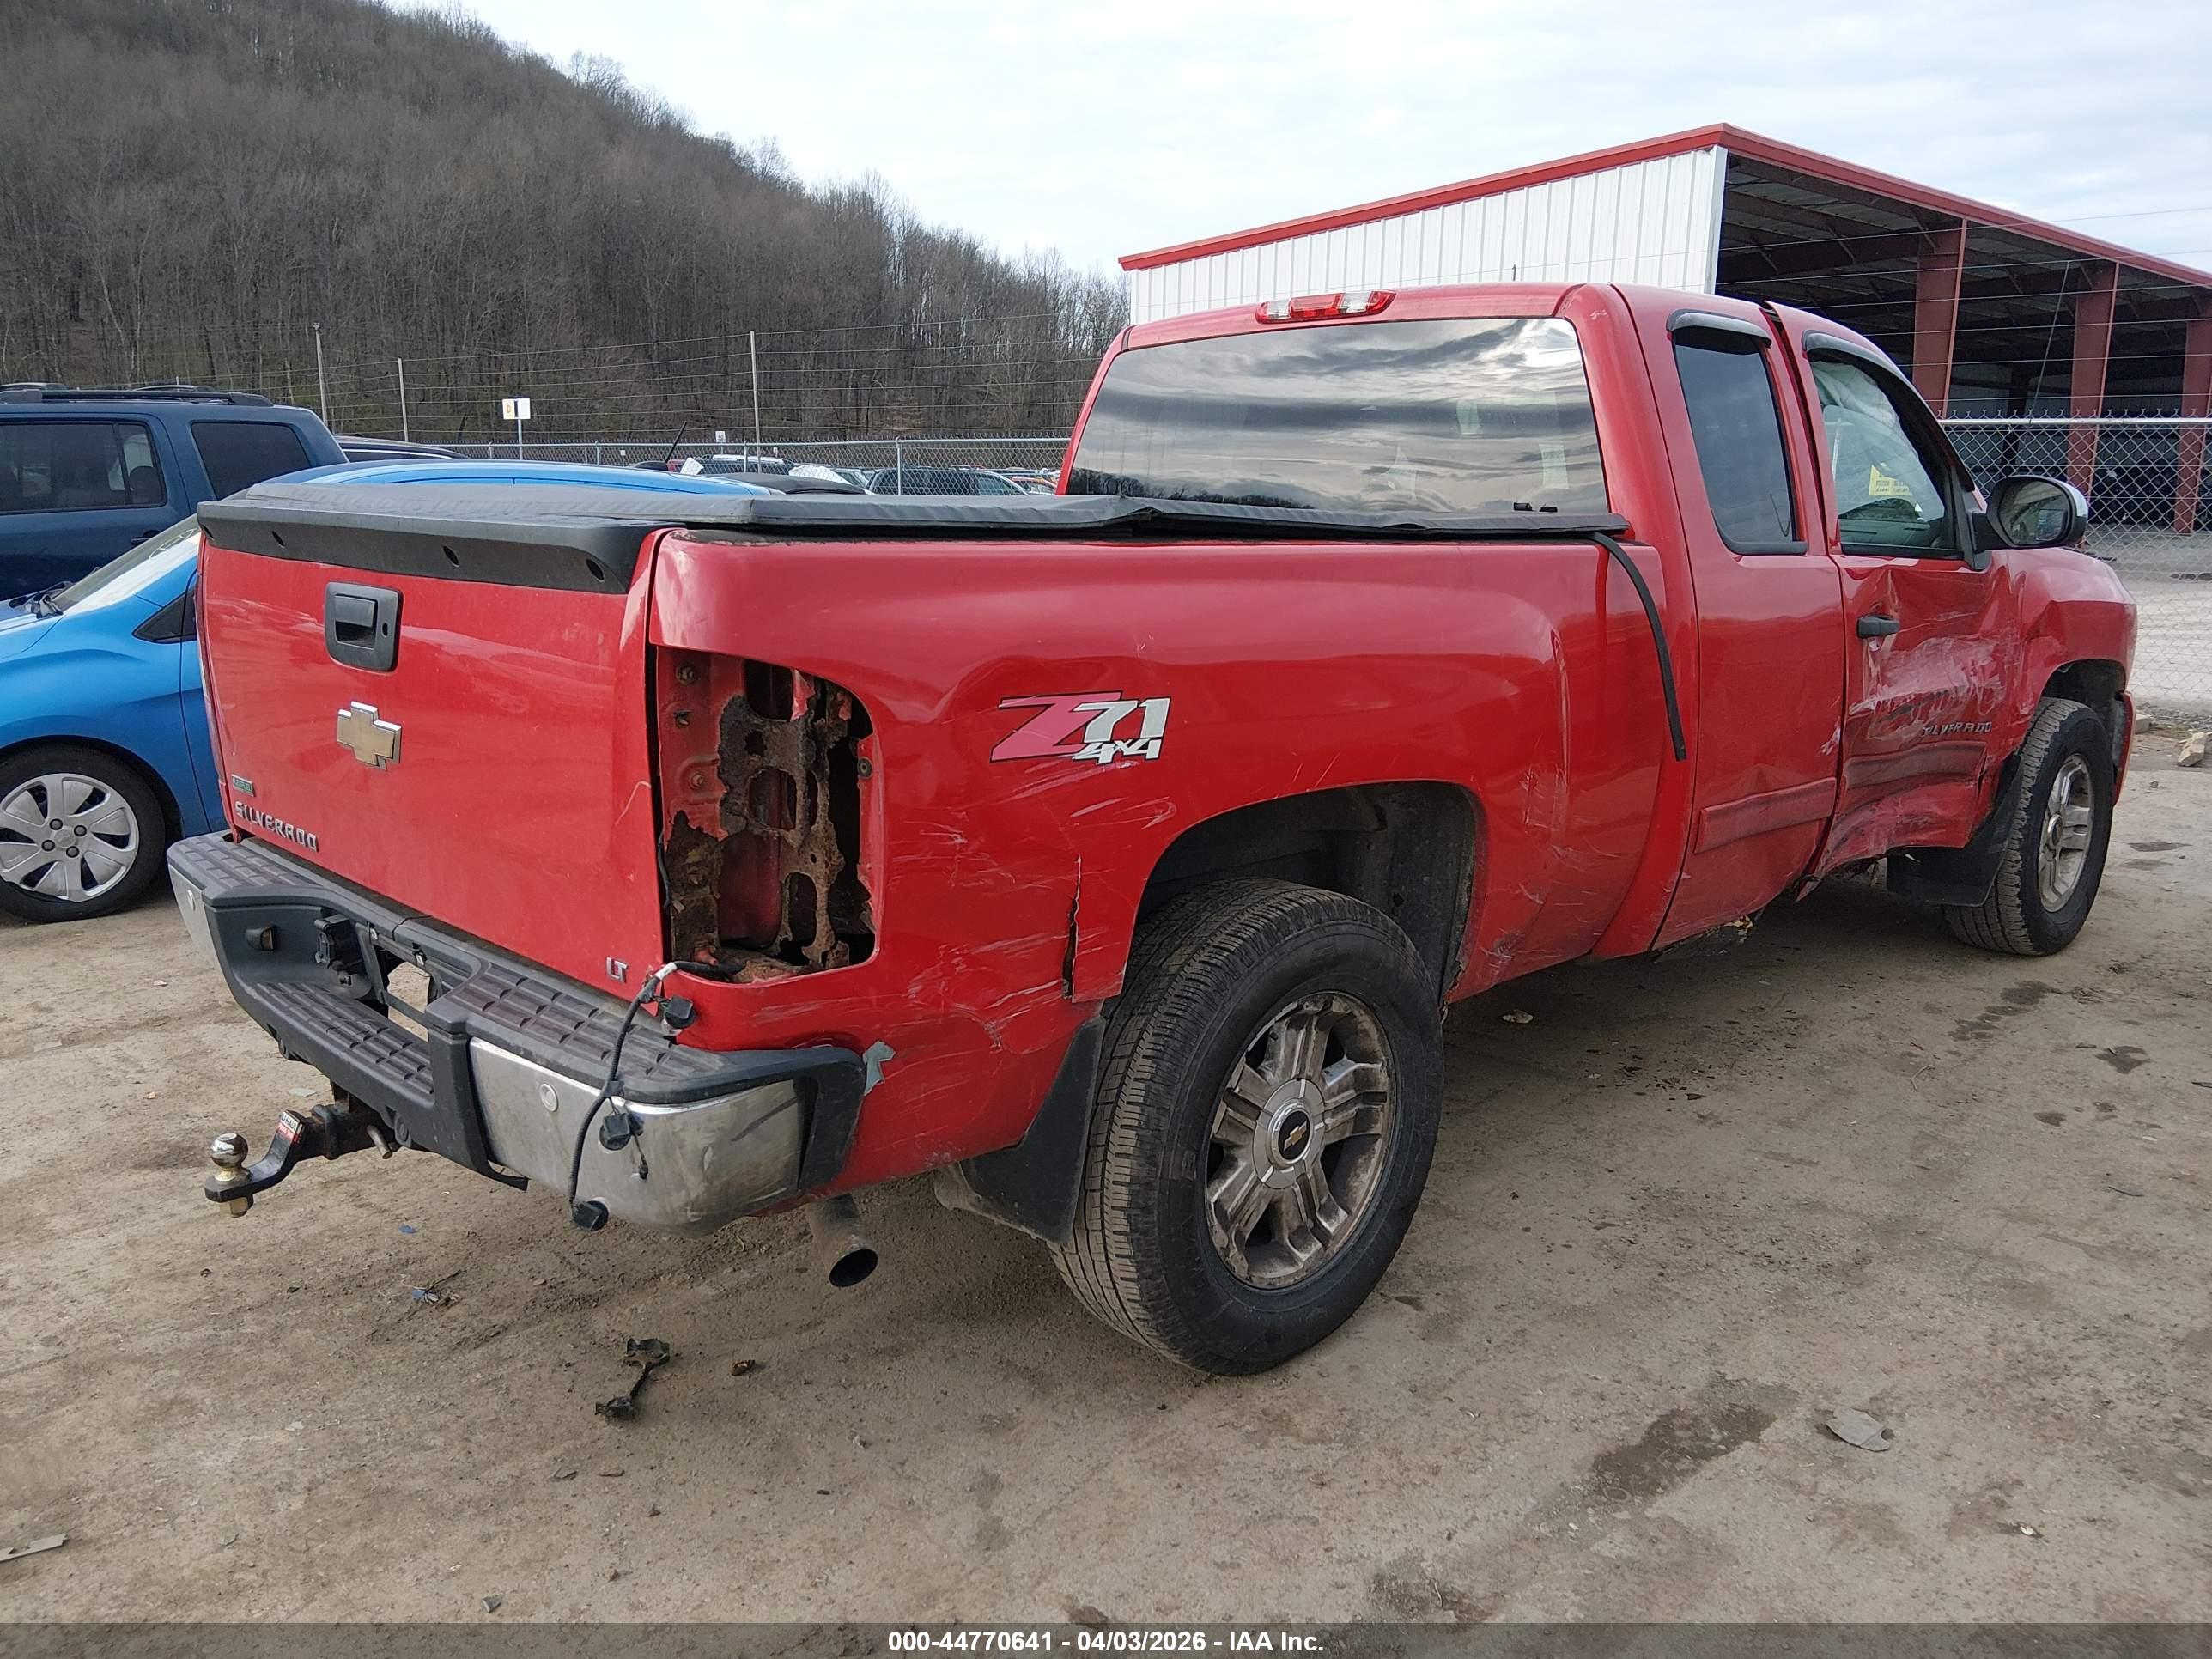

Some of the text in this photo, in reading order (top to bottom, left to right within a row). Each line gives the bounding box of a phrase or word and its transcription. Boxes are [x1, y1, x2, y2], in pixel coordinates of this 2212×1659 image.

[990, 690, 1171, 763] Z71
[234, 800, 319, 853] SILVERADO
[606, 957, 629, 984] LT
